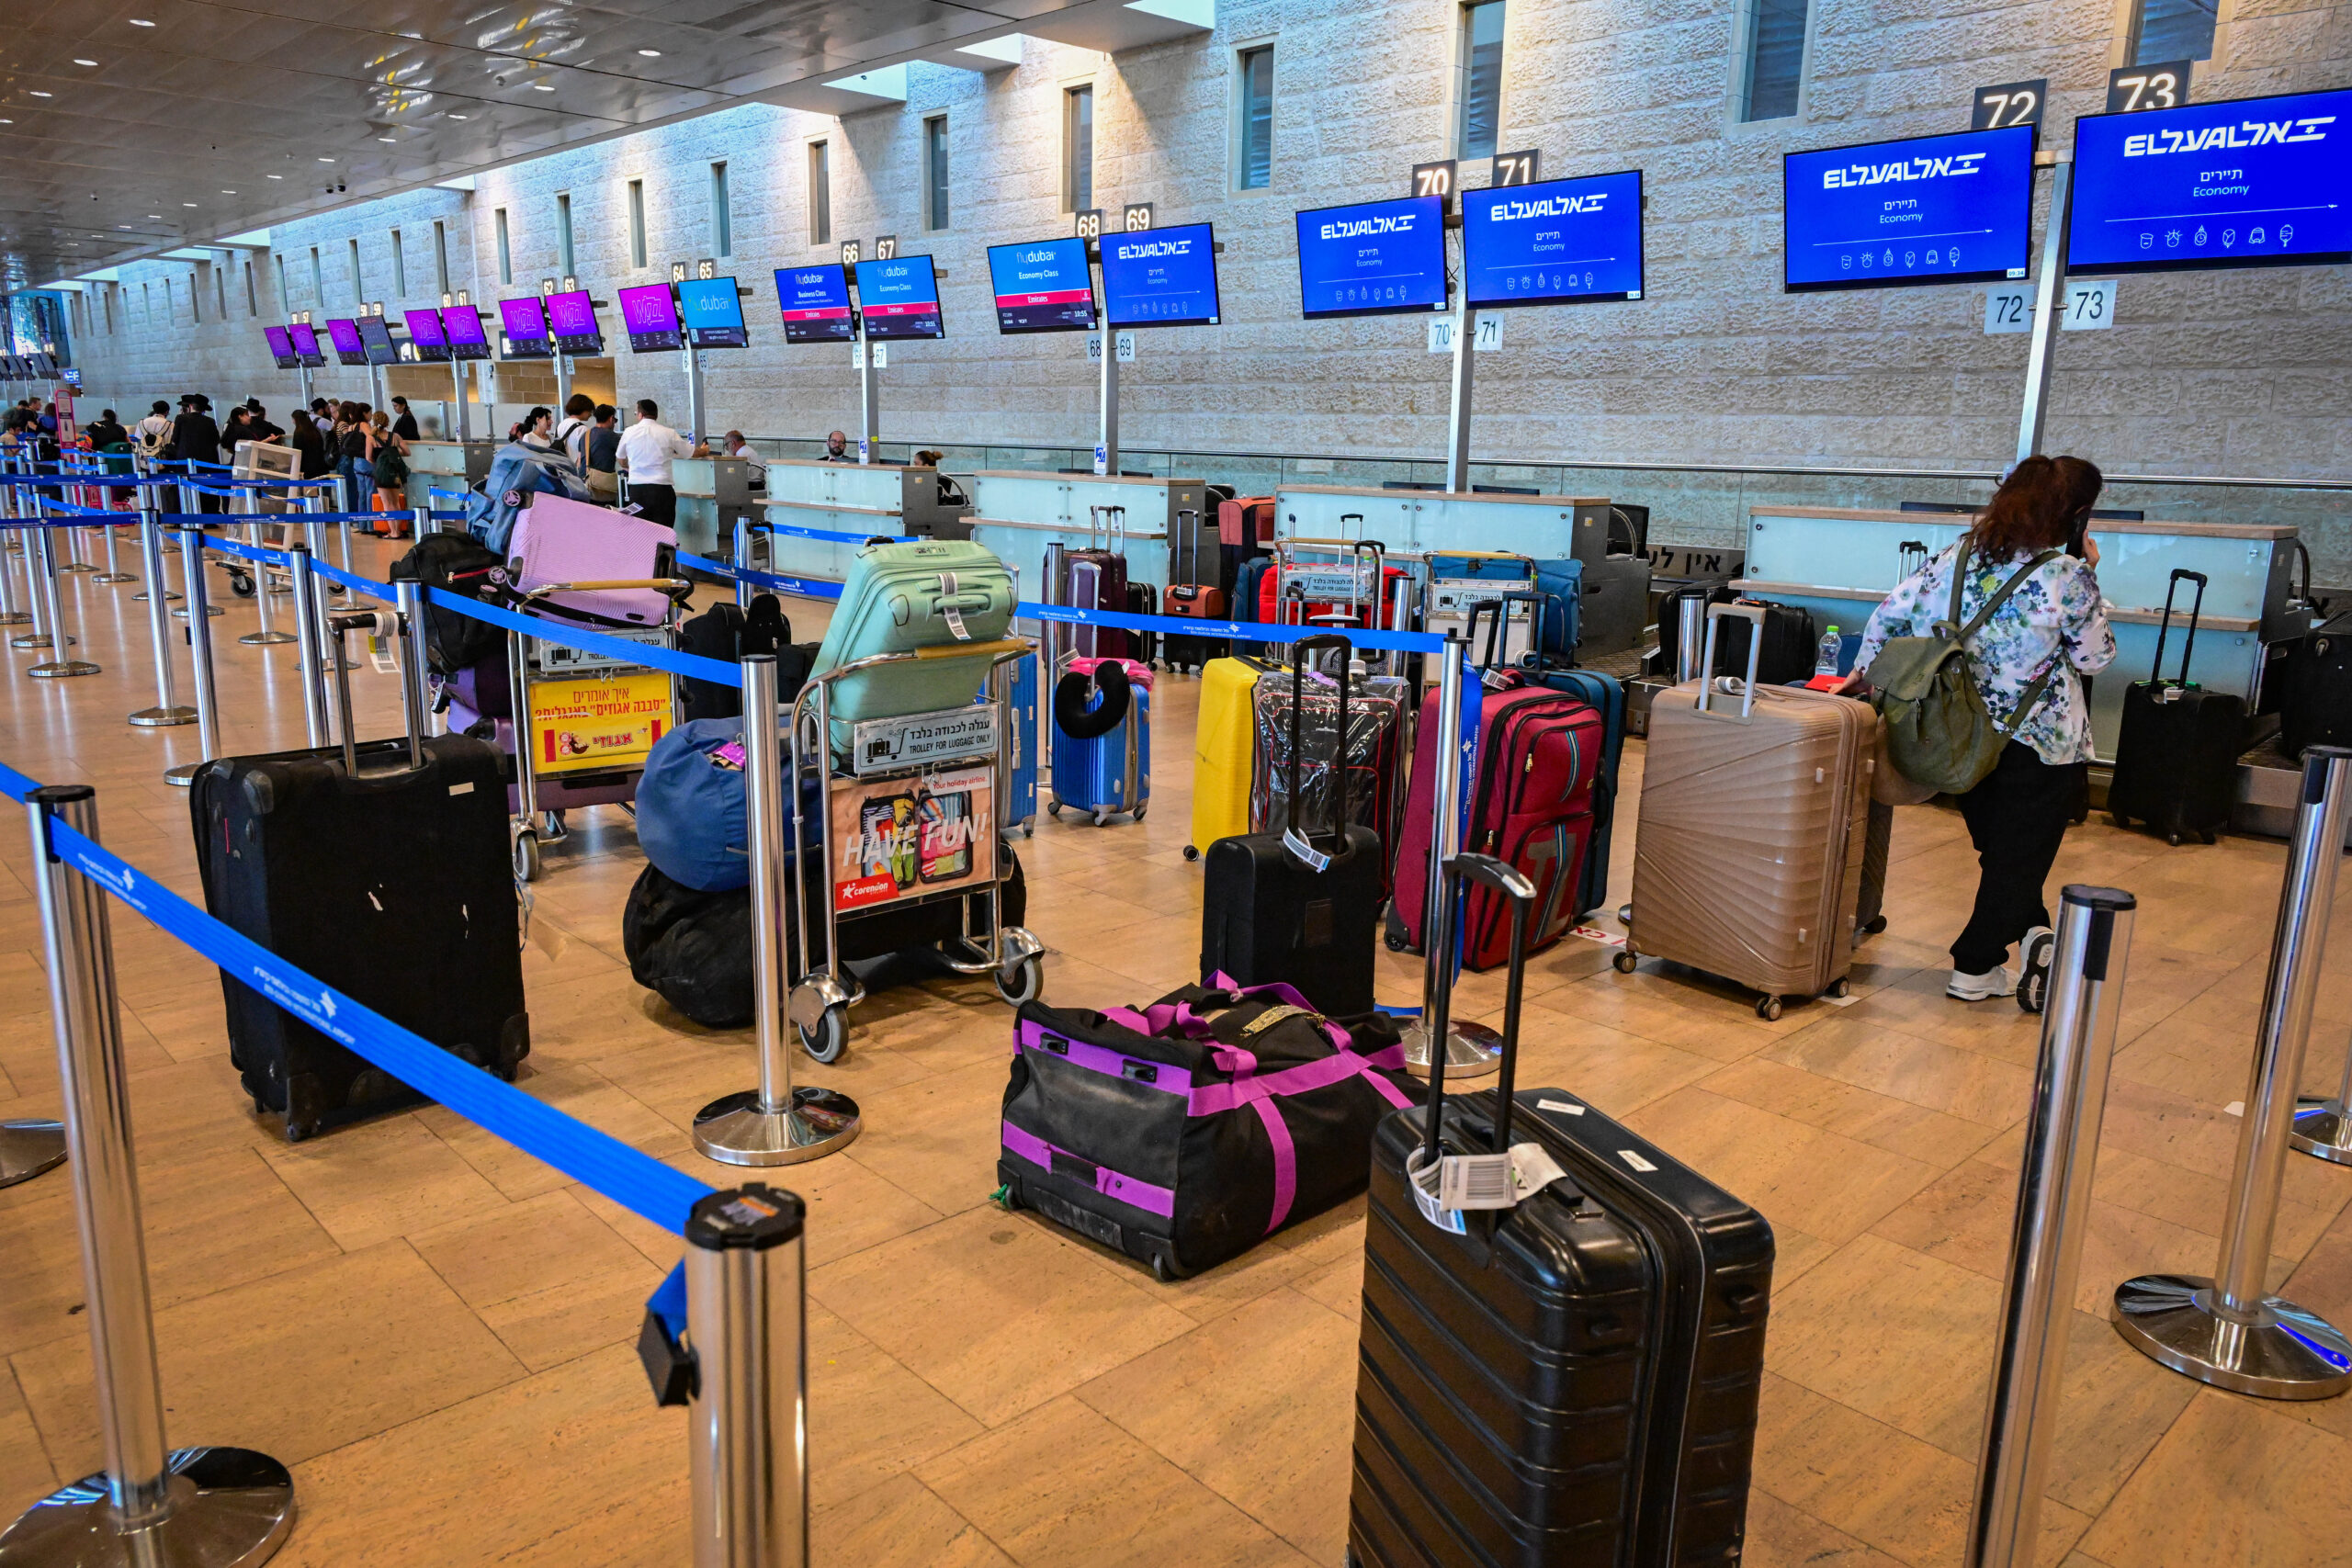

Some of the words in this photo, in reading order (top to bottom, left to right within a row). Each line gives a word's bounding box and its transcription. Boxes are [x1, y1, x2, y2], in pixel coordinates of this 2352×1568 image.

[2117, 73, 2177, 111] 73
[1984, 91, 2036, 129] 72
[1498, 157, 1531, 186] 71
[2200, 169, 2243, 182] תיירים
[1418, 168, 1450, 196] 70
[2193, 185, 2249, 197] Economy
[1884, 198, 1917, 210] תיירים
[1078, 215, 1099, 237] 68
[1126, 209, 1149, 231] 69
[1880, 212, 1923, 224] Economy
[843, 243, 858, 264] 66
[877, 241, 894, 259] 67
[1533, 243, 1565, 252] Economy
[699, 262, 712, 279] 65
[1356, 259, 1383, 267] Economy
[673, 265, 684, 283] 64
[1996, 295, 2023, 323] 72
[2075, 290, 2104, 320] 73
[1434, 323, 1450, 345] 70
[1482, 321, 1497, 343] 71
[1090, 340, 1102, 357] 68
[1120, 338, 1131, 356] 69
[876, 349, 884, 364] 67
[1685, 553, 1721, 574] אין
[573, 689, 609, 703] אומרים
[612, 688, 629, 702] איך
[910, 727, 933, 739] בלבד
[935, 721, 966, 736] לכבודה
[968, 718, 989, 731] עגלה
[910, 743, 933, 754] TROLLEY
[935, 741, 946, 750] FOR
[948, 737, 974, 749] LUGGAGE
[977, 734, 990, 744] ONLY
[947, 779, 968, 787] holiday
[843, 824, 918, 867] HAVE
[924, 813, 988, 852] FUN!
